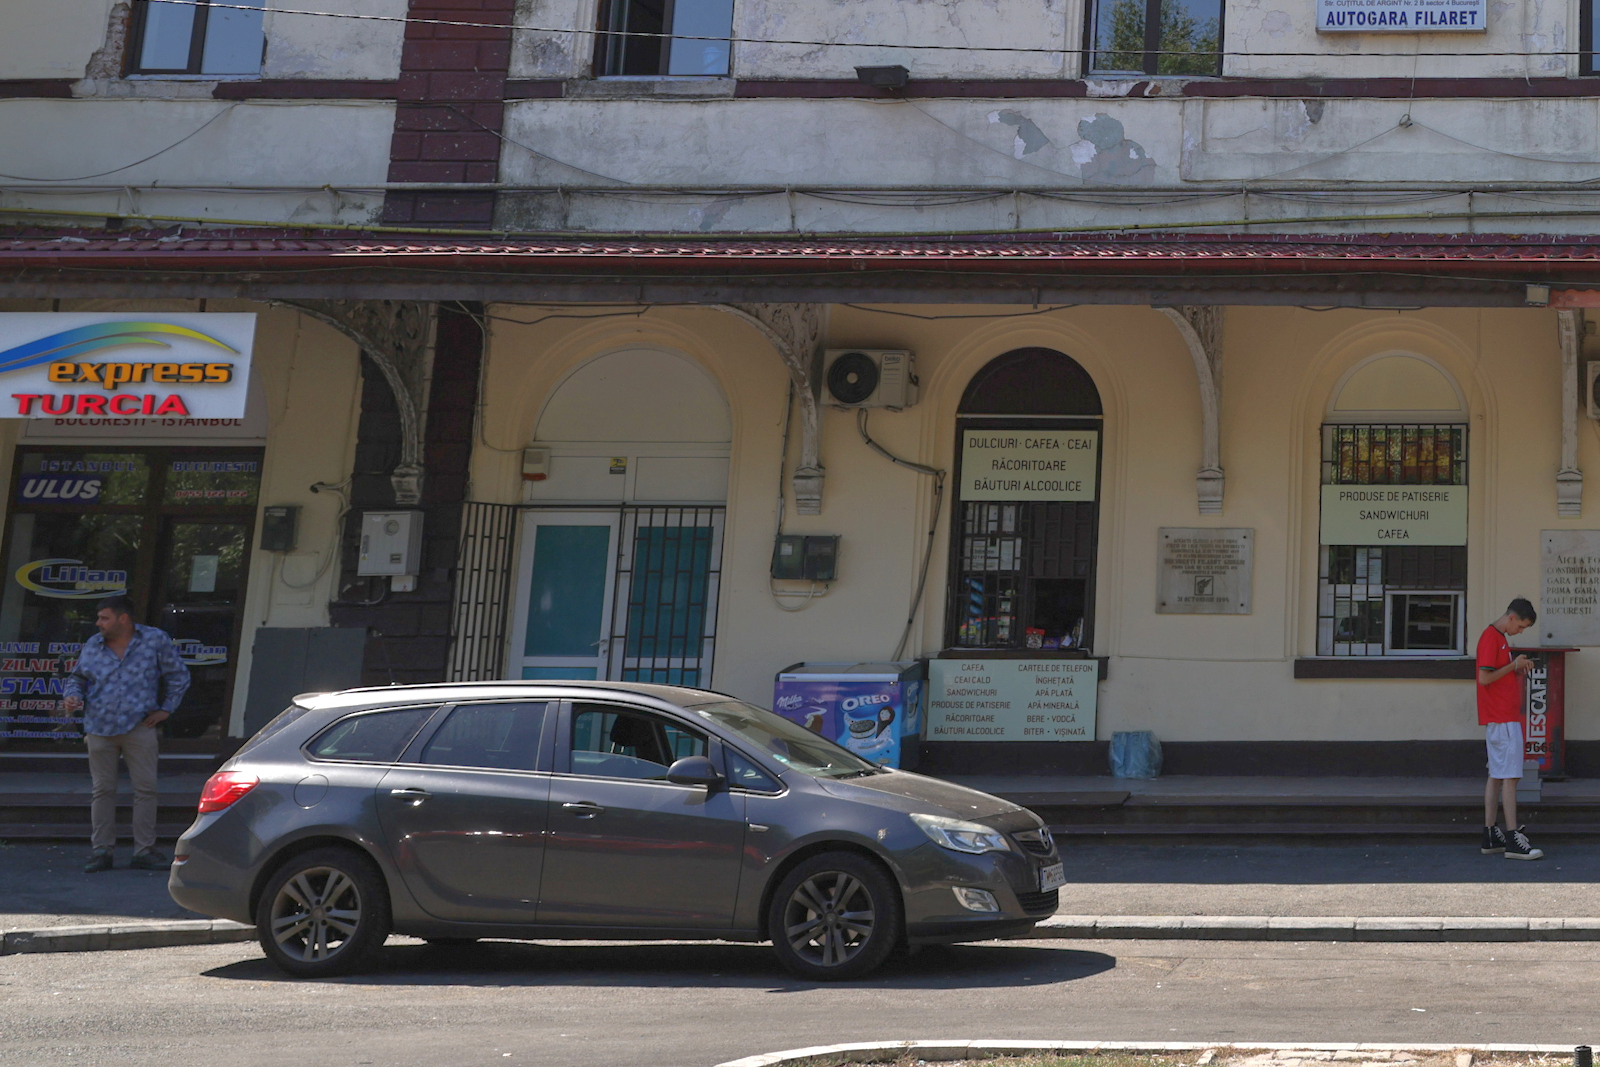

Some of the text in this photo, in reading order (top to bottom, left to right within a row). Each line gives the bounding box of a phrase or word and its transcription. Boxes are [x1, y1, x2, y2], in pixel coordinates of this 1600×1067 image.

[1366, 0, 1376, 7] DE
[1377, 0, 1402, 7] ARGINT
[1404, 0, 1412, 7] Nr.
[1426, 0, 1444, 7] sector
[1326, 10, 1478, 26] AUTOGARA FILARET
[48, 362, 234, 390] express
[11, 393, 190, 415] TURCIA
[970, 437, 1092, 450] DULCIURI CAFEA CEAI
[40, 460, 136, 472] ISTANBUL
[172, 461, 258, 473] BUCURESTI
[992, 457, 1066, 471] RĂCORITOARE
[22, 479, 102, 499] ULUS
[974, 477, 1082, 492] BĂUTURI ALCOOLICE
[1340, 491, 1449, 501] PRODUSE DE PATISERIE
[1360, 511, 1429, 520] SANDWICHURI
[1377, 529, 1410, 539] CAFEA
[40, 566, 127, 583] Lilian
[1547, 577, 1571, 585] GARA
[1546, 587, 1571, 595] PRIMA
[2, 658, 60, 673] ZILNIC
[962, 663, 984, 671] CAFEA
[1018, 664, 1050, 672] CARTELE
[946, 689, 997, 697] SANDWICHURI
[1035, 689, 1073, 697] APĂ PLATĂ
[0, 699, 84, 711] EL: 0755 32
[776, 694, 803, 708] Milka
[841, 694, 891, 711] OREO
[931, 701, 1011, 709] PRODUSE DE PATISERIE
[1027, 700, 1080, 709] APĂ MINERALĂ
[945, 713, 995, 723] RĂCORITOARE
[1026, 713, 1076, 723] BERE VODCĂ
[934, 725, 1005, 735] BĂUTURI ALCOOLICE
[1024, 727, 1044, 735] BITER
